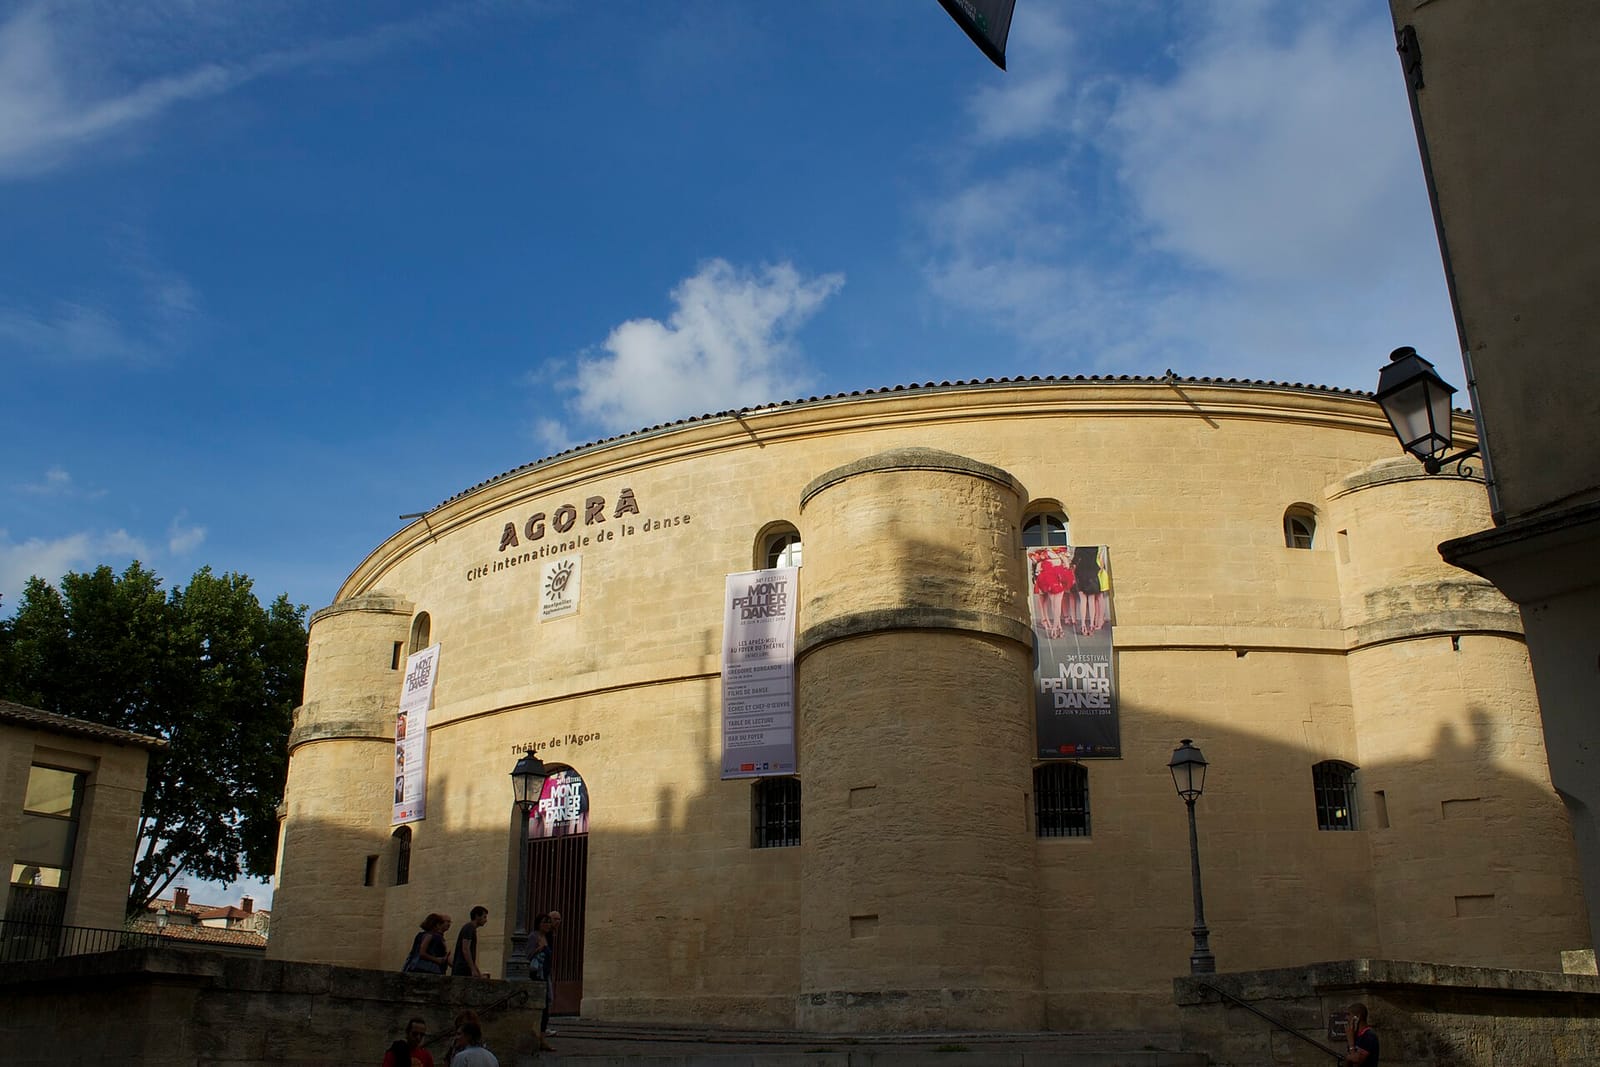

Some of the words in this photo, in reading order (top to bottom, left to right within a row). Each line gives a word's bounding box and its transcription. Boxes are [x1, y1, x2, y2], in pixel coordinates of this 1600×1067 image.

[498, 487, 640, 552] AGORA
[467, 564, 489, 581] Cité
[493, 535, 590, 573] internationale
[597, 529, 614, 543] de
[621, 524, 635, 537] la
[643, 514, 691, 532] danse
[747, 581, 787, 596] MONT
[732, 592, 787, 610] PELLIER
[741, 605, 786, 620] DANSE
[415, 655, 433, 671] MONT
[1058, 662, 1109, 679] MONT
[406, 665, 431, 684] PELLIER
[408, 678, 429, 692] DANSE
[1040, 677, 1110, 694] PELLIER
[1054, 692, 1111, 709] DANSE
[511, 742, 546, 755] Théâtre
[549, 737, 561, 748] de
[564, 732, 601, 746] l'Agora
[550, 782, 581, 799] MONT
[538, 794, 581, 813] PELLIER
[545, 808, 580, 823] DANSE
